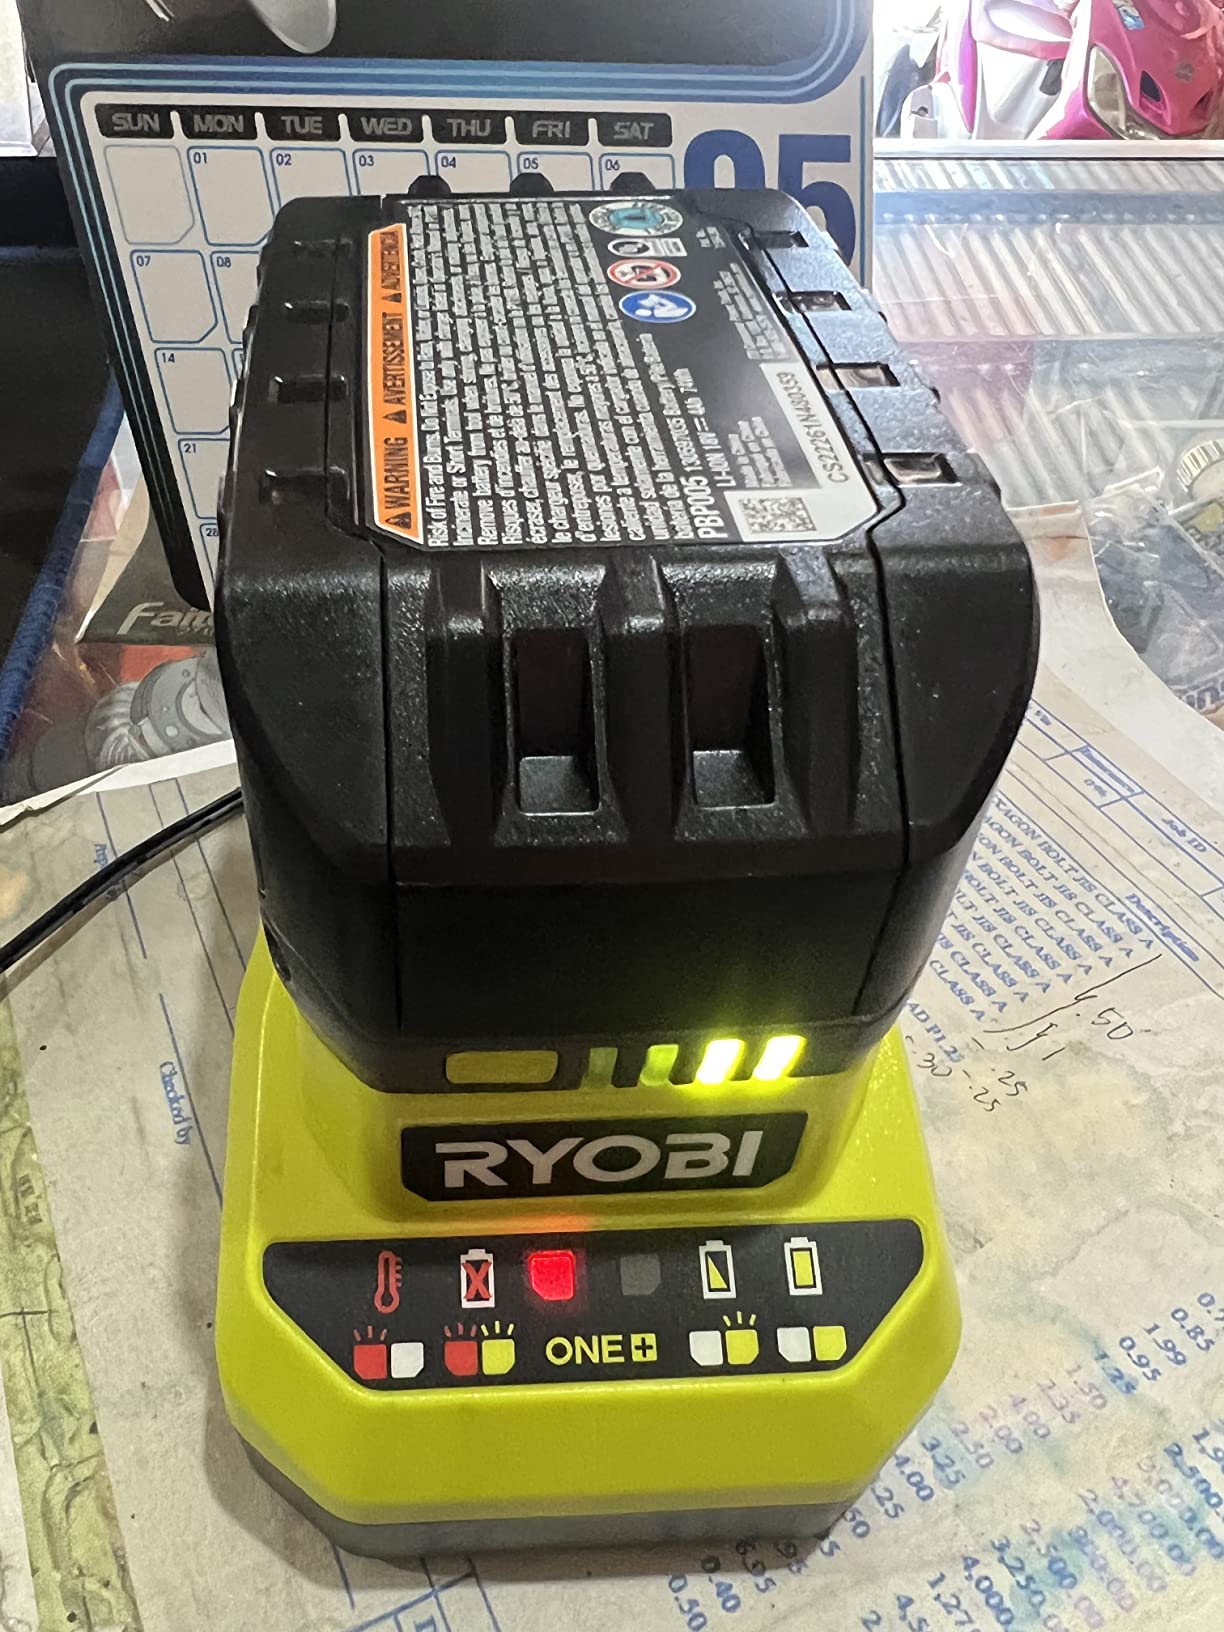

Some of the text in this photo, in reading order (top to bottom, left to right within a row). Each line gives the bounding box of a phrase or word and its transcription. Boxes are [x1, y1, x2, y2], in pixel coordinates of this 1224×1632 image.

[112, 113, 654, 141] SUN MON TUE WED THU FRI SAT
[193, 152, 620, 171] 01 02 03 04 05 06
[136, 255, 231, 268] 07 08
[162, 353, 175, 364] 14
[184, 443, 196, 454] 21
[445, 445, 465, 473] Short
[706, 452, 735, 486] LI-ION
[383, 436, 410, 508] WARNING
[423, 464, 443, 484] and
[451, 475, 467, 487] or
[471, 459, 491, 495] battery
[589, 473, 612, 491] por
[425, 486, 445, 505] Fire
[425, 507, 446, 518] of
[451, 490, 472, 545] Incinerate
[545, 481, 568, 529] chargeur
[595, 495, 620, 541] lesiones
[681, 476, 726, 538] PBP005
[427, 520, 448, 546] Risk
[477, 499, 497, 544] Remove
[501, 499, 523, 544] Risques
[640, 501, 669, 539] unidad
[1161, 817, 1207, 853] Job ID
[993, 794, 1041, 841] XAGON
[1037, 841, 1079, 875] BOLT
[1072, 873, 1098, 893] JIS
[1095, 893, 1143, 936] CLASS
[1138, 938, 1153, 950] A
[978, 863, 1019, 897] BOLT
[1013, 900, 1039, 917] JIS
[1034, 917, 1082, 961] CLASS
[1077, 963, 1093, 976] A
[999, 856, 1113, 968] BOLT JIS CLASS A
[1017, 850, 1058, 882] BOLT
[1053, 883, 1077, 902] JIS
[1074, 901, 1123, 944] CLASS
[1118, 947, 1133, 959] A
[951, 922, 1029, 1003] JIS CLASS A
[972, 915, 998, 933] JIS
[993, 934, 1040, 978] CLASS
[1035, 981, 1051, 994] A
[993, 907, 1018, 925] JIS
[1014, 925, 1061, 970] CLASS
[1056, 973, 1073, 984] A
[929, 960, 985, 1021] CLASS A
[950, 950, 997, 997] CLASS
[992, 1001, 1008, 1013] A
[159, 1061, 195, 1145] Checked by
[435, 1131, 763, 1190] RYOBI
[1144, 1323, 1187, 1366] 1.99
[1171, 1308, 1214, 1352] 0.85
[1095, 1352, 1137, 1394] 1.25
[1119, 1336, 1162, 1381] 0.95
[1066, 1365, 1107, 1409] 1.50
[952, 1421, 994, 1469] 2.50
[979, 1405, 1023, 1453] 2.00
[921, 1437, 967, 1485] 3.25
[668, 1574, 707, 1632] 0.50
[701, 1555, 741, 1613] 0.40
